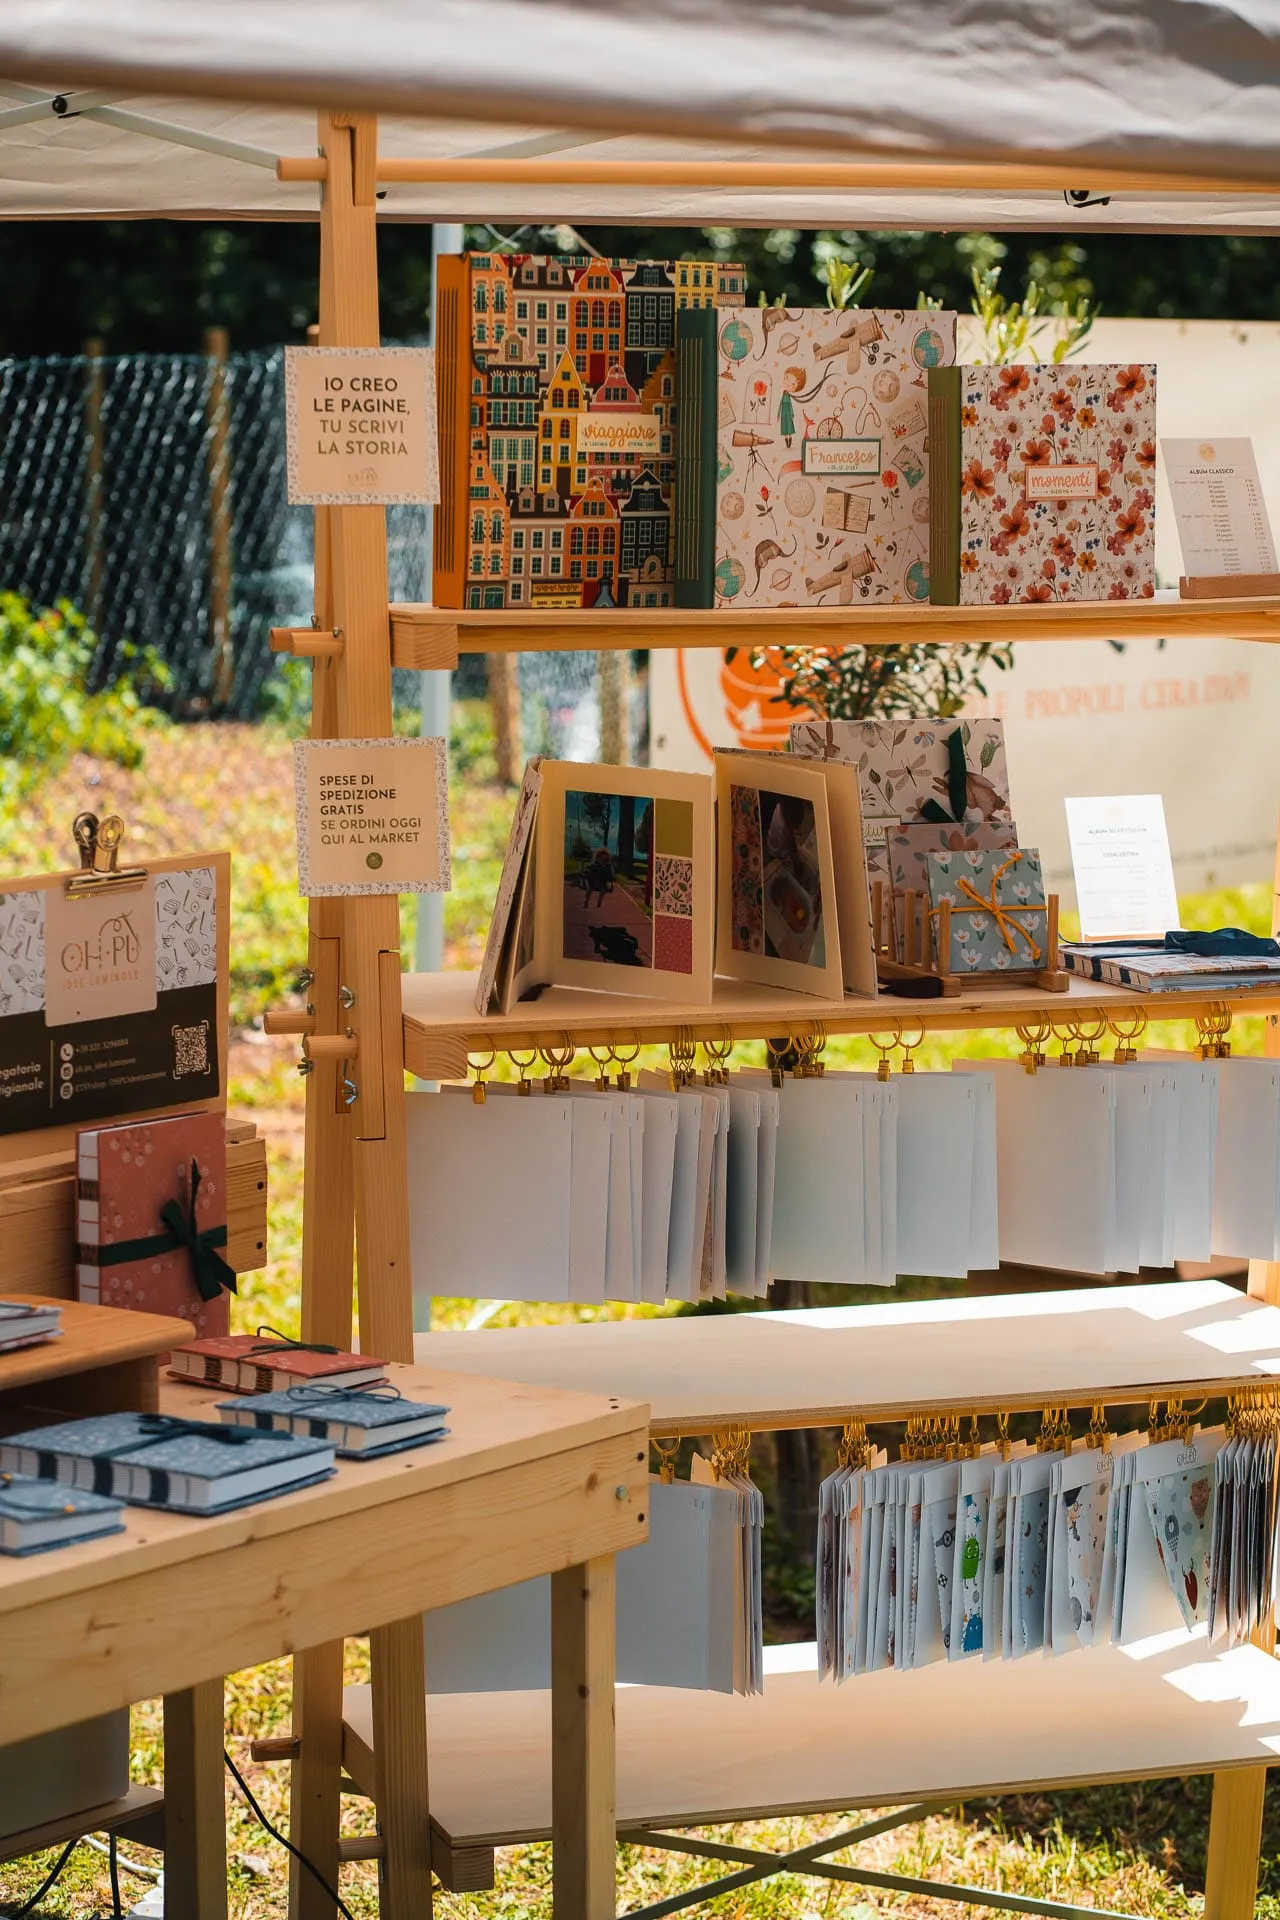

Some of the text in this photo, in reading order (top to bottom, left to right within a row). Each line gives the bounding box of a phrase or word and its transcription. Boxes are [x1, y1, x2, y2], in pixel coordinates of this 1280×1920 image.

[324, 377, 398, 392] IO CREO
[313, 398, 411, 416] LE PAGINE,
[320, 419, 404, 434] TU SCRIVI
[583, 420, 656, 448] viaggiare
[318, 440, 409, 455] LA STORIA
[808, 446, 876, 466] Francesco
[1031, 471, 1092, 488] momenti
[319, 775, 374, 786] SPESE DI
[320, 788, 397, 801] SPEDIZIONE
[320, 804, 365, 815] GRATIS
[320, 817, 422, 830] SE ORDINI OGGI
[321, 831, 420, 845] QUI AL MARKET
